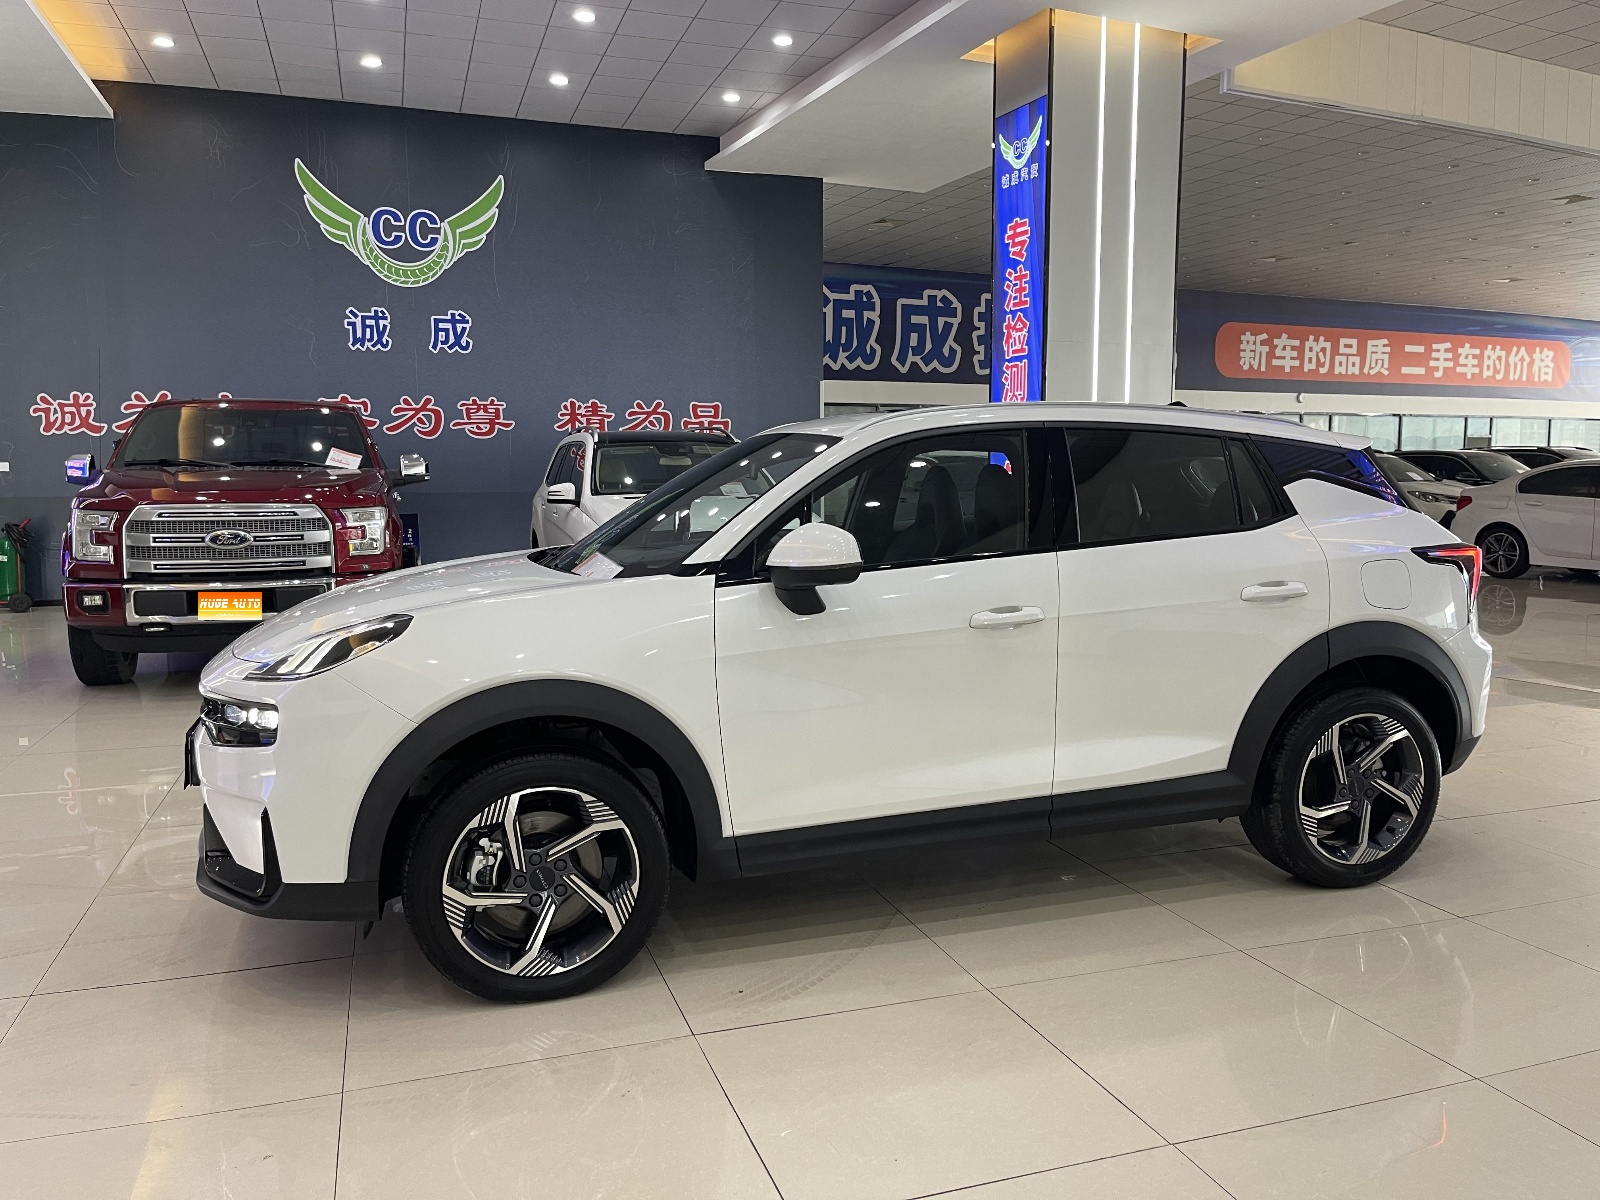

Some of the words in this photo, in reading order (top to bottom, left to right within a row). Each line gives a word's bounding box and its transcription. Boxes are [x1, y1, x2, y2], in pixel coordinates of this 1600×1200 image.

[368, 207, 441, 250] CC
[344, 307, 473, 353] 诚成
[1002, 218, 1031, 402] 专注检测
[1239, 331, 1391, 377] 新车的品质
[1400, 342, 1555, 382] 二手车的价格
[216, 533, 241, 545] Ford
